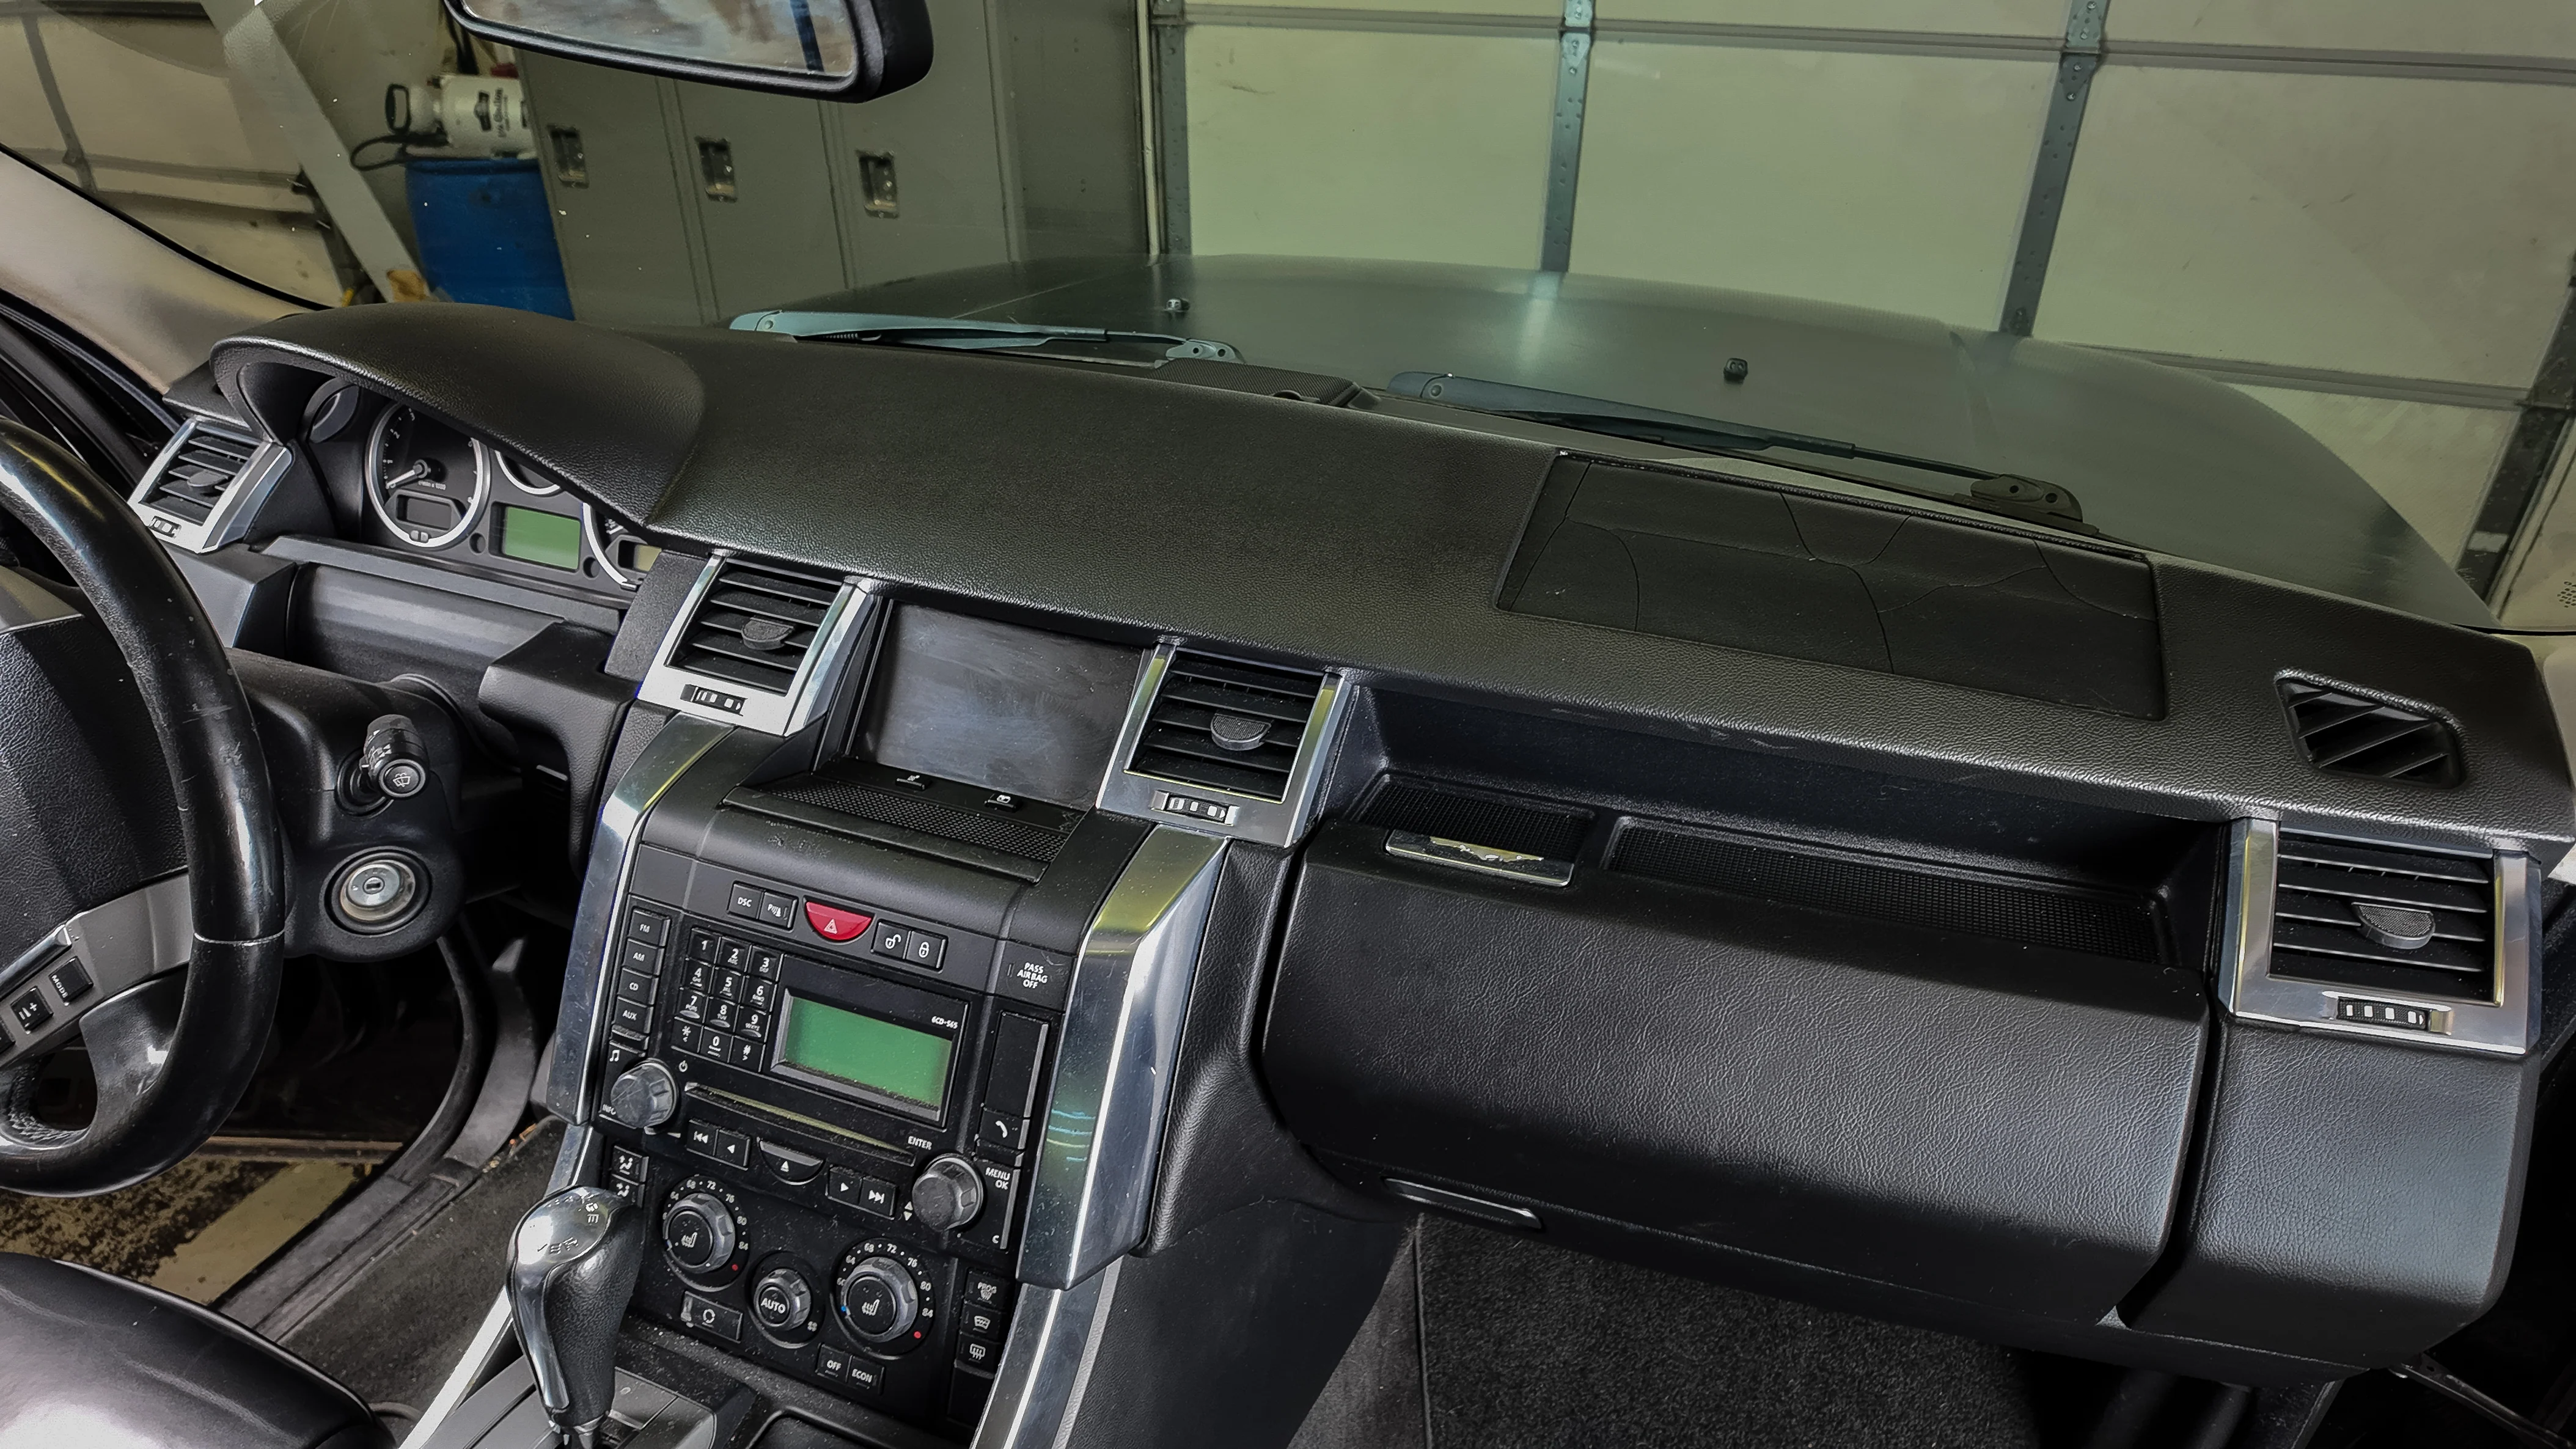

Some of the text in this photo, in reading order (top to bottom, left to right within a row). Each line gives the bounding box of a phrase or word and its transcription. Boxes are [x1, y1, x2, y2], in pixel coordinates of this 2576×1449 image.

[738, 897, 752, 908] DSC
[640, 923, 650, 933] FM
[701, 940, 708, 950] 1
[633, 952, 645, 962] AM
[731, 948, 739, 959] 2
[761, 957, 769, 967] 3
[694, 967, 702, 978] 4
[1024, 962, 1044, 974] PASS
[1016, 969, 1048, 983] AIRBAG
[51, 975, 68, 998] MODE
[725, 977, 732, 987] 5
[1022, 979, 1038, 989] OFF
[757, 985, 764, 996] 6
[691, 995, 697, 1005] 7
[720, 1004, 727, 1014] 8
[622, 1010, 637, 1021] AUX
[751, 1014, 758, 1024] 9
[713, 1036, 720, 1046] 0
[908, 1135, 933, 1150] ENTER
[985, 1167, 1011, 1181] MENU
[706, 1180, 716, 1190] 72
[995, 1179, 1009, 1190] OK
[736, 1216, 747, 1225] 80
[993, 1234, 999, 1244] C
[738, 1241, 749, 1250] 84
[864, 1242, 875, 1253] 68
[887, 1243, 897, 1253] 72
[846, 1255, 856, 1264] 64
[908, 1257, 917, 1267] 76
[920, 1281, 931, 1291] 80
[978, 1282, 997, 1294] PROG
[760, 1297, 785, 1314] AUTO
[922, 1308, 933, 1318] 84
[827, 1360, 842, 1371] OFF
[851, 1368, 873, 1383] ECON
